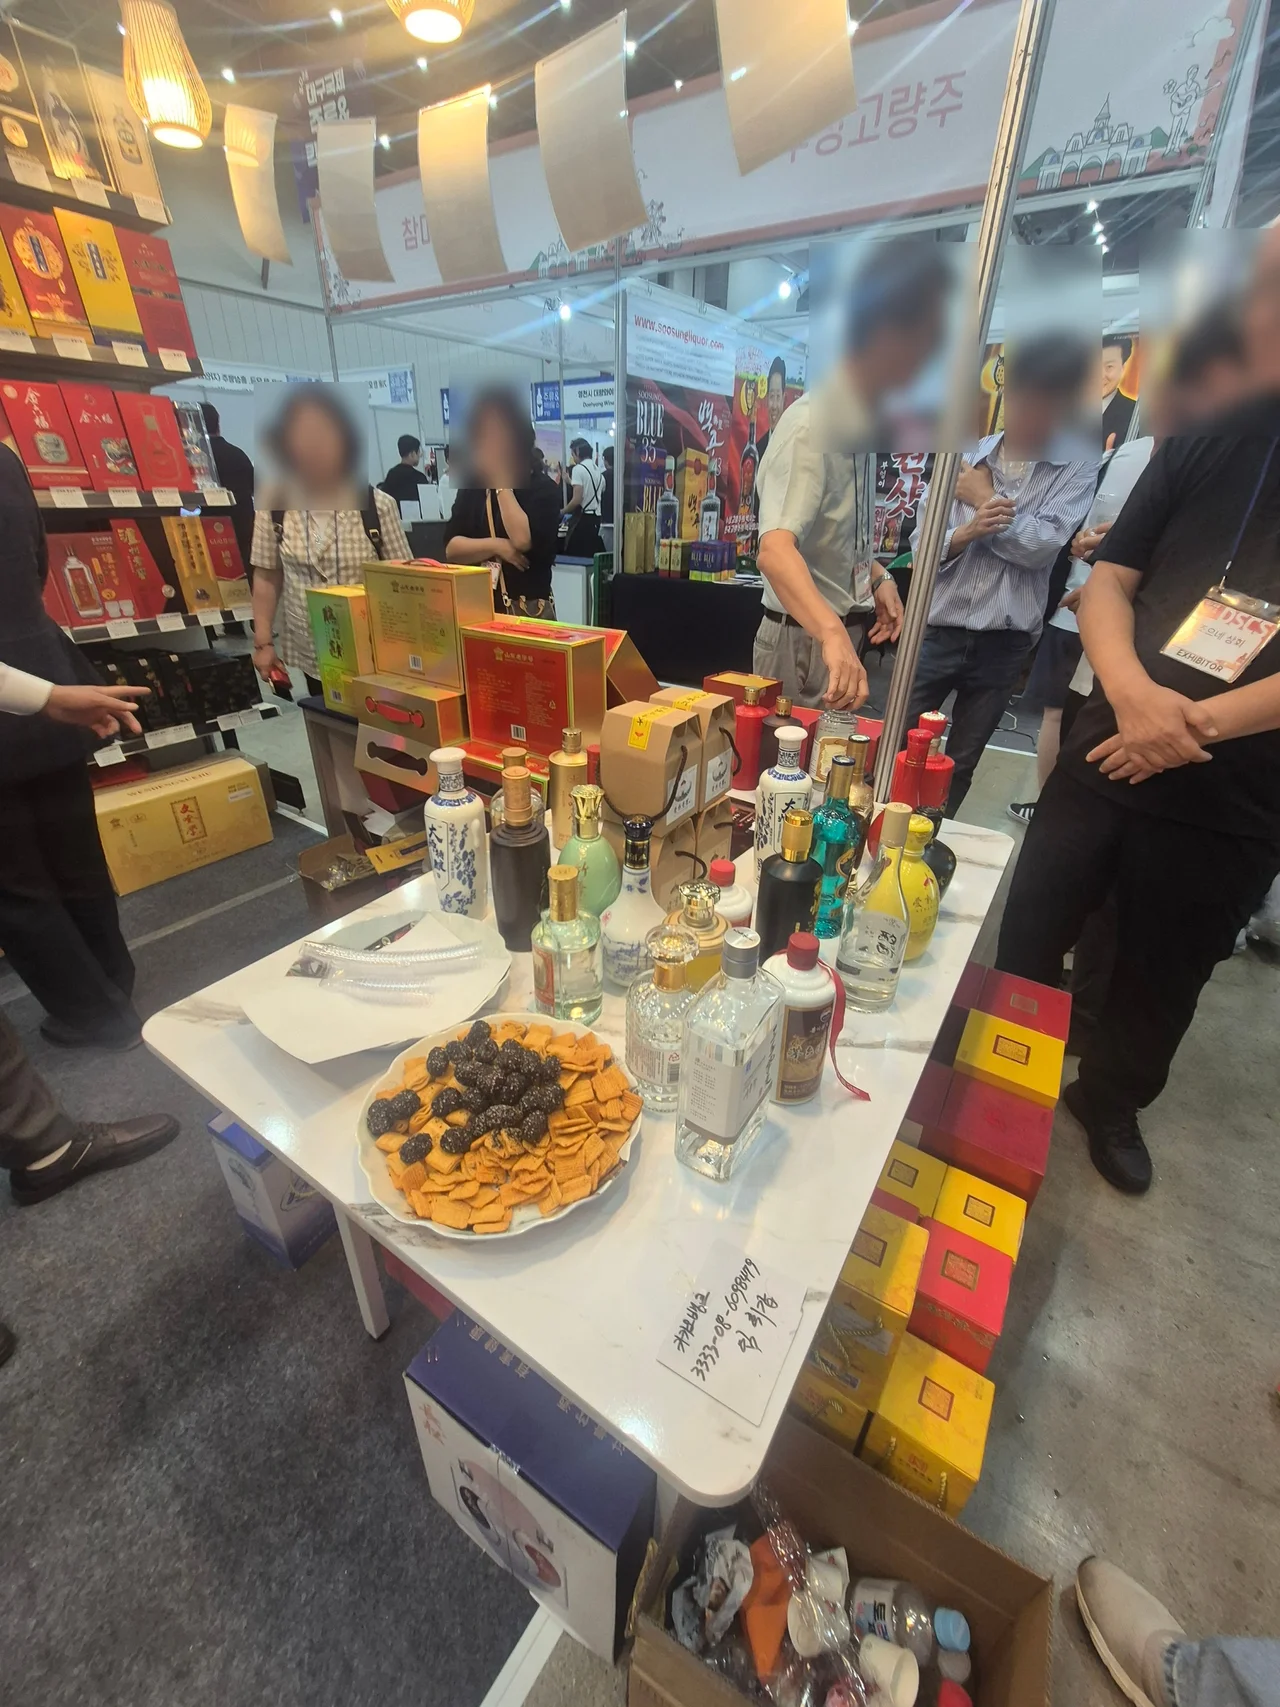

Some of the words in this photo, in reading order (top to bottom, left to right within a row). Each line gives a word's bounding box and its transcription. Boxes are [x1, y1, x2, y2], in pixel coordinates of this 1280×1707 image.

[634, 314, 725, 351] www.soosungliquor.com
[636, 400, 664, 438] BLUE
[641, 438, 657, 464] 35
[1218, 606, 1270, 636] DSCS
[1225, 634, 1247, 649] 상회
[1176, 648, 1224, 673] EXHIBITOR
[673, 1290, 711, 1353] 카카오뱅크
[690, 1257, 761, 1382] 3333-08-6098479
